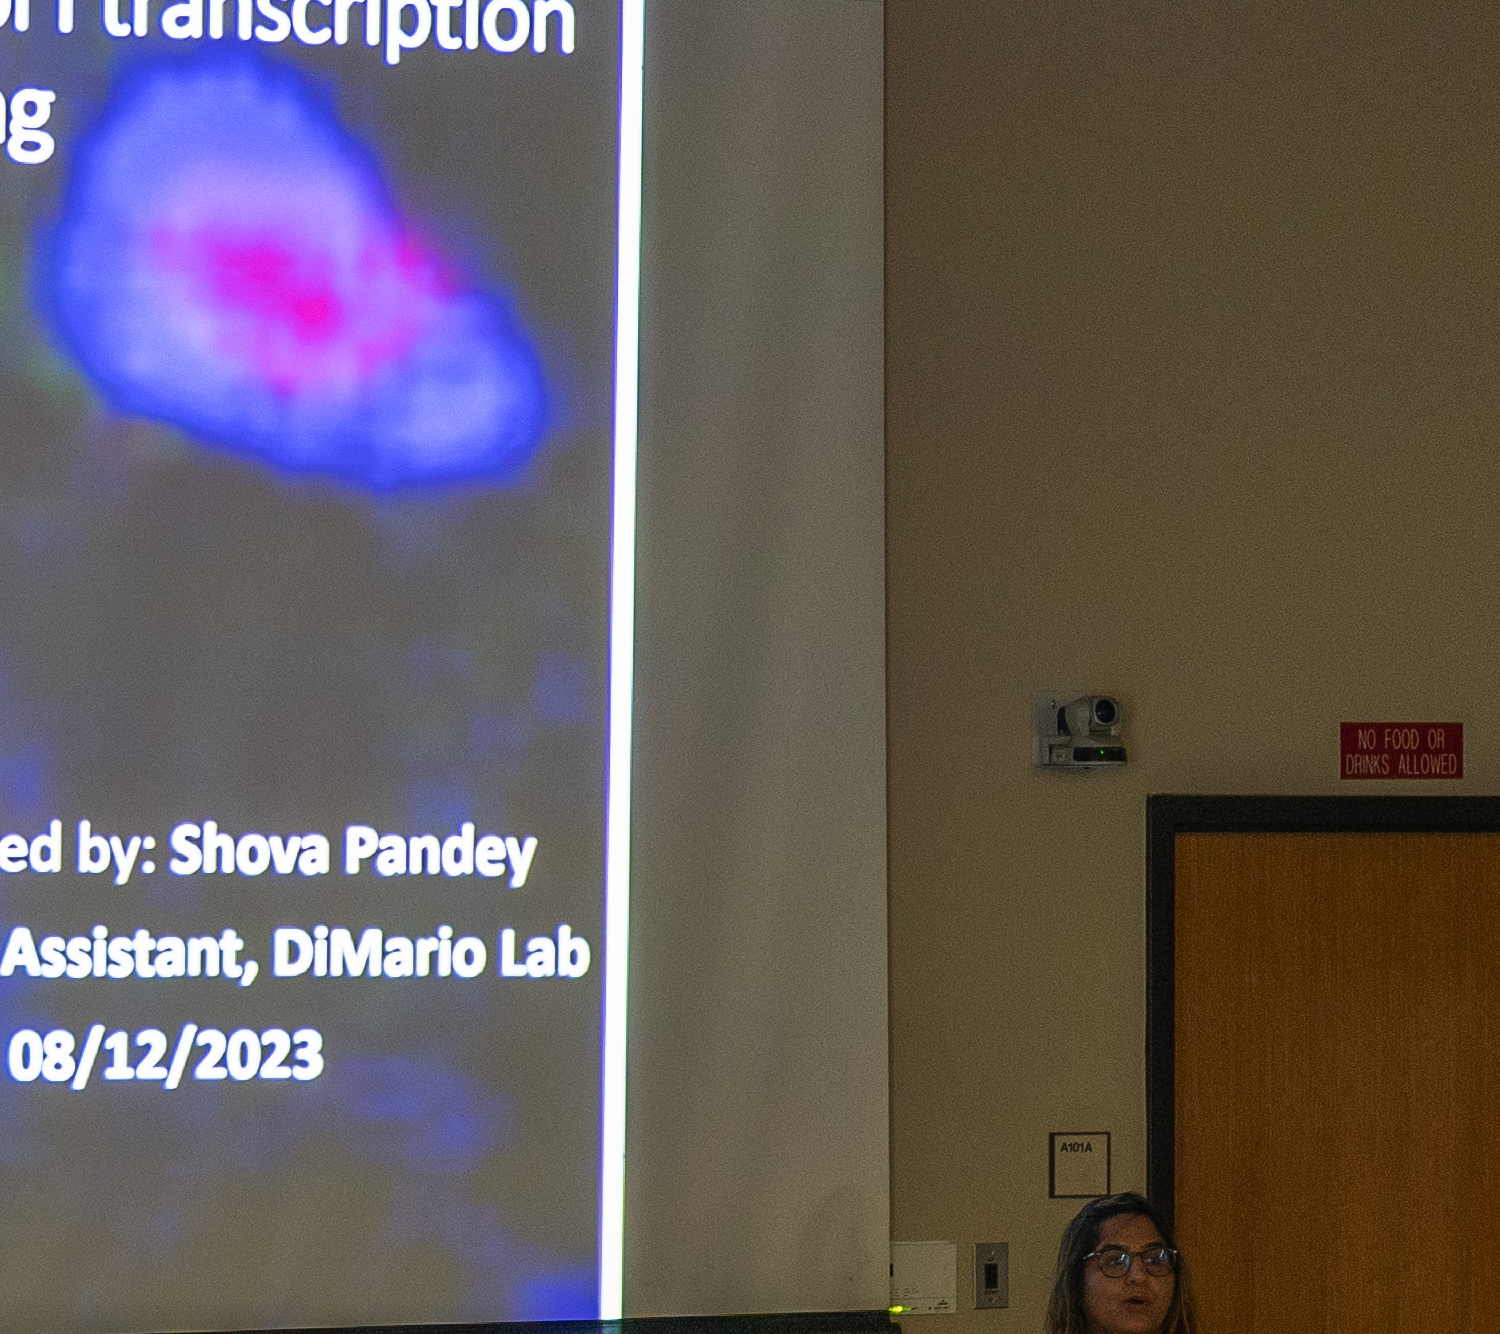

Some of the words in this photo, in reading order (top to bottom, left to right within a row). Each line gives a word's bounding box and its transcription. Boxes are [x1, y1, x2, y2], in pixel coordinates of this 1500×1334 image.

[1357, 728, 1377, 750] NO
[1384, 728, 1420, 750] FOOD
[1427, 728, 1446, 750] OR
[1345, 753, 1390, 776] DRINKS
[1398, 753, 1458, 776] ALLOWED
[77, 819, 157, 886] by:
[168, 820, 331, 876] Shova
[344, 822, 539, 888] Pandey
[273, 925, 488, 978] DiMario
[500, 924, 592, 978] Lab
[8, 1023, 325, 1091] 08/12/2023
[1060, 1141, 1093, 1153] A101A
